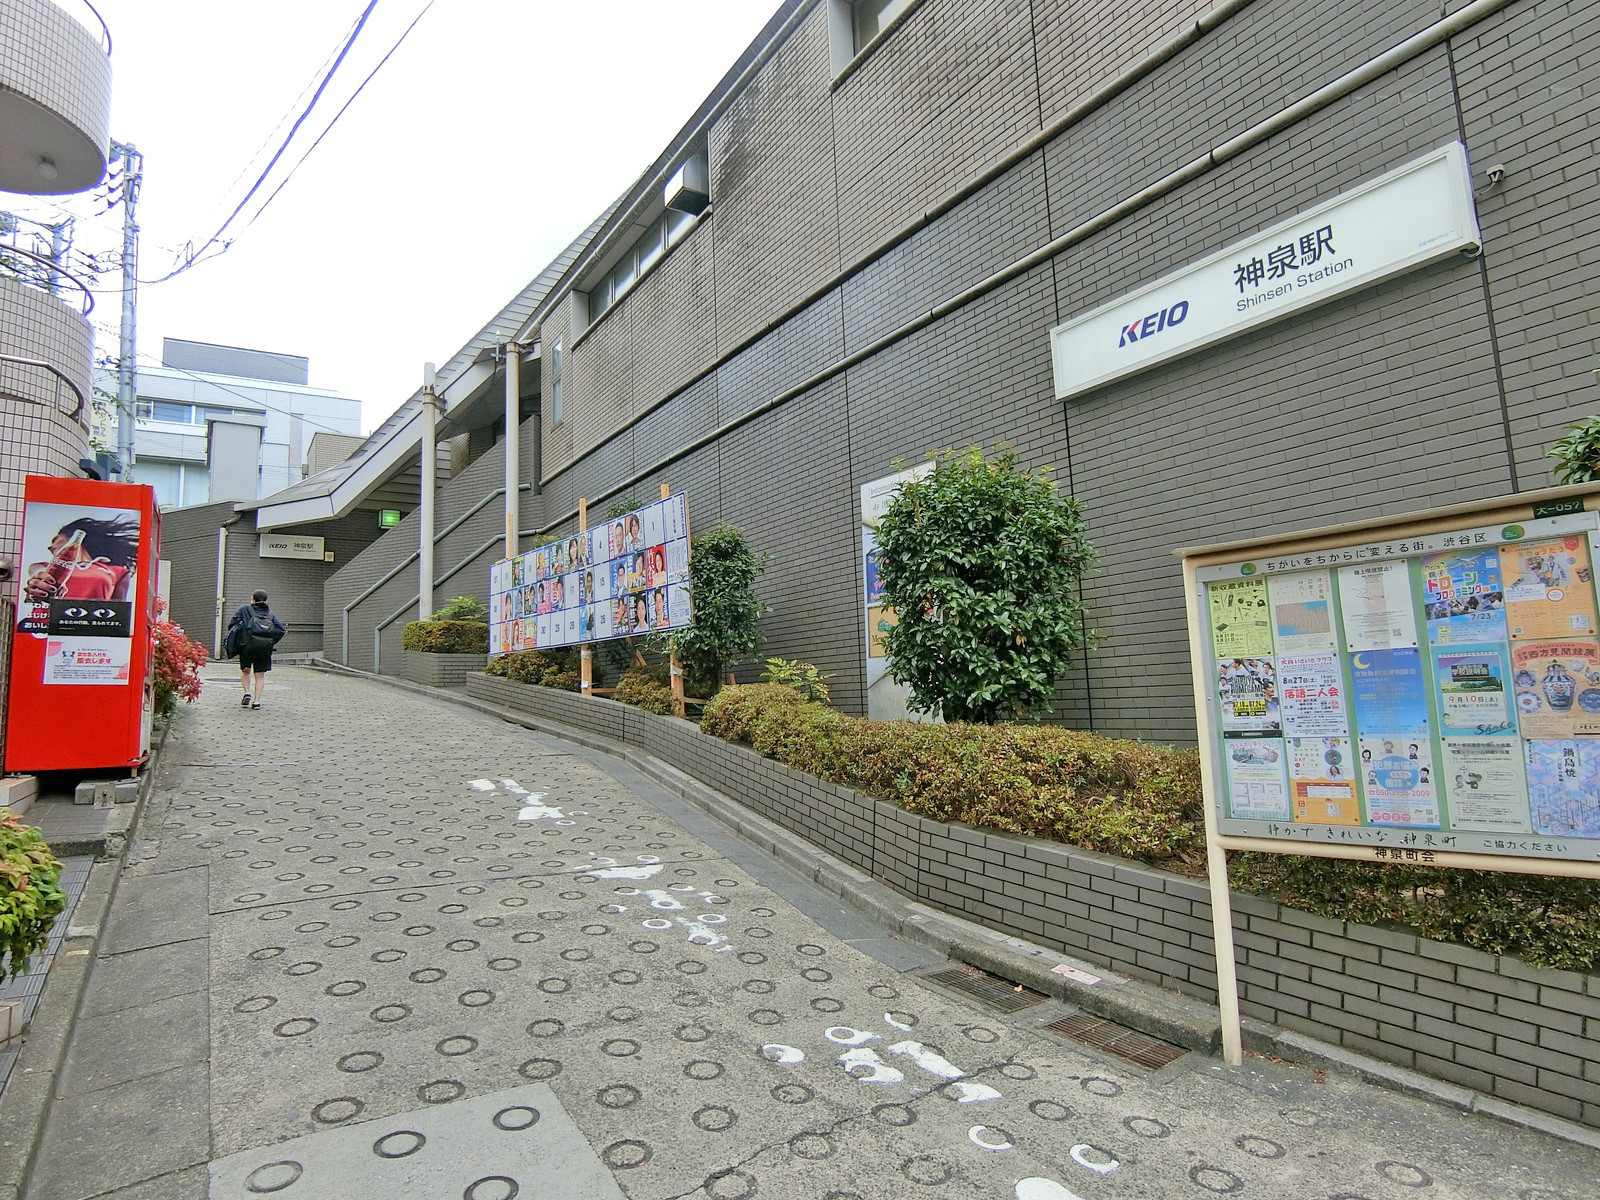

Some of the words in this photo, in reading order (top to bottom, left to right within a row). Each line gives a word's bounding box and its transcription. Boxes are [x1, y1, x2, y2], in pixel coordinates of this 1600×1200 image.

[1233, 224, 1336, 293] 神泉駅
[1236, 282, 1293, 312] Shinsen
[1297, 256, 1353, 288] Station
[1118, 300, 1189, 349] KEIO
[870, 480, 901, 496] Informatio
[1427, 572, 1478, 594] ドローン
[1284, 686, 1339, 699] 落語二人会
[1448, 695, 1498, 704] 9月10日(土)
[1374, 847, 1435, 863] 神泉町会
